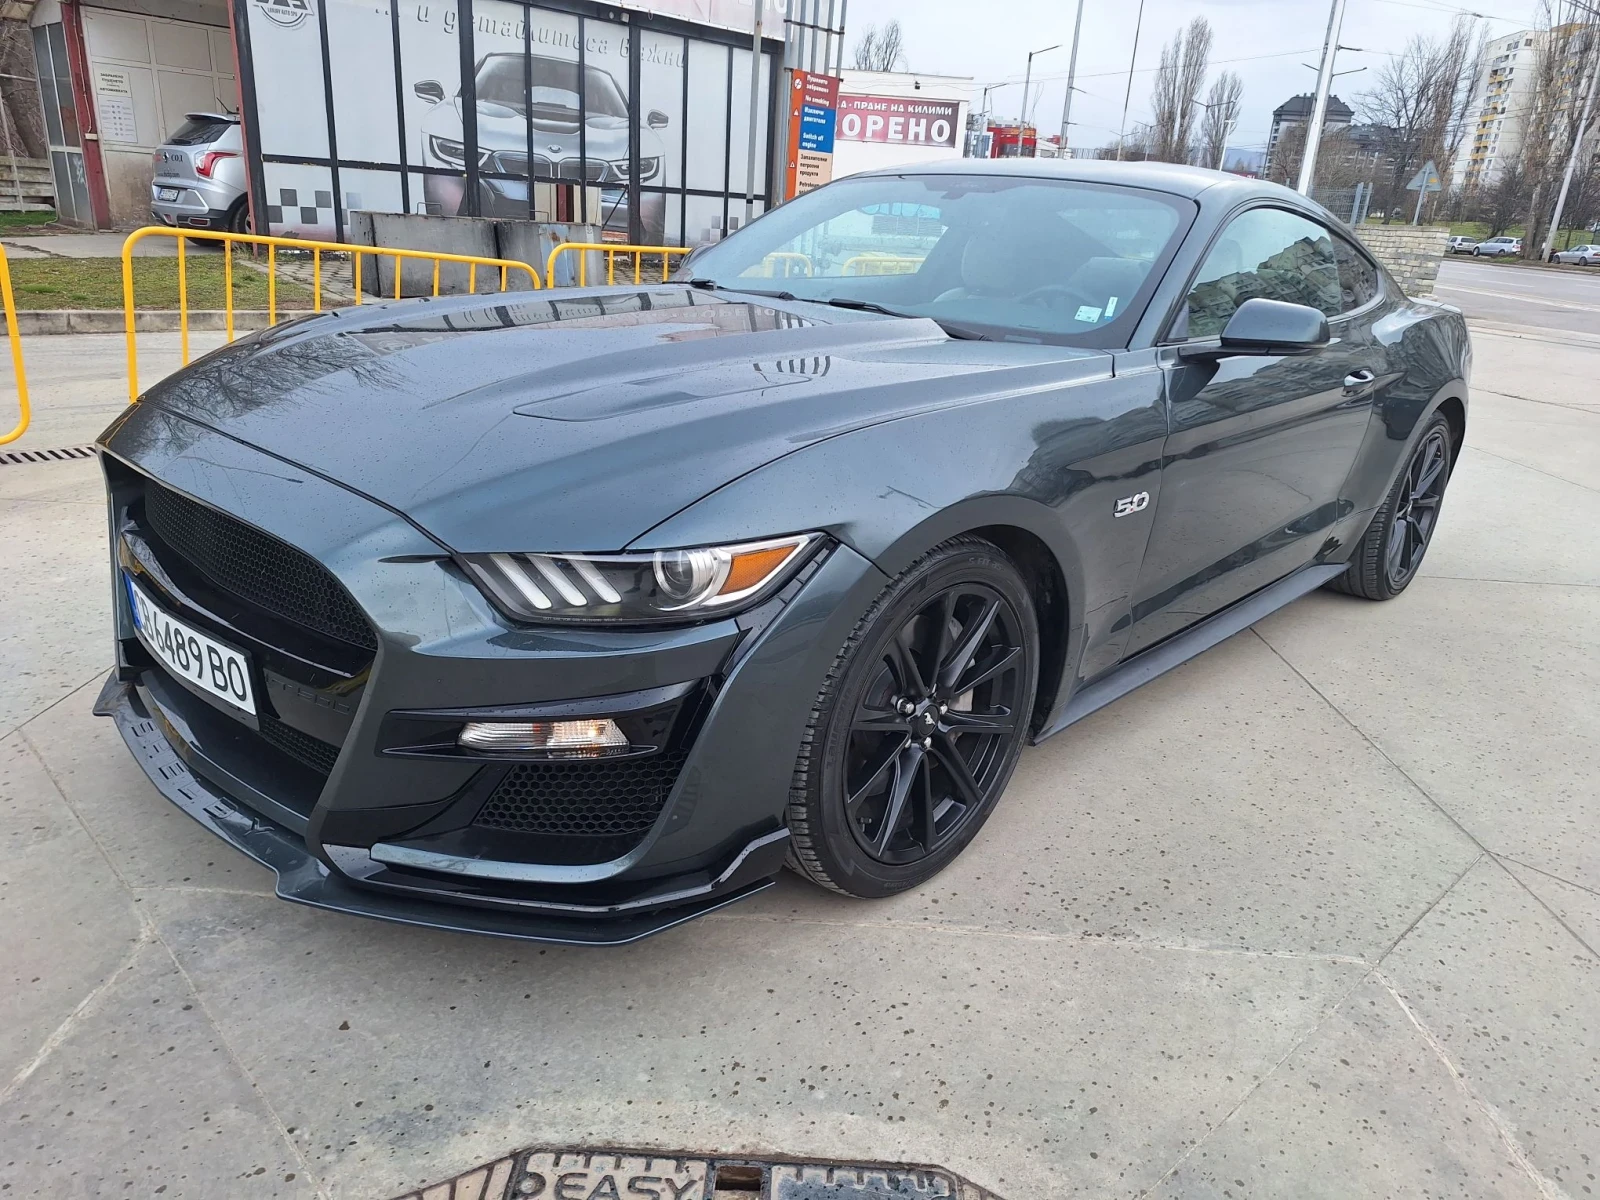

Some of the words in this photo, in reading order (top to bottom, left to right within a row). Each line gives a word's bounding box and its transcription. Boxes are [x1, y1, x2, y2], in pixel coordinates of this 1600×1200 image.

[804, 94, 812, 102] No
[811, 97, 830, 107] smoking
[853, 101, 888, 112] ПРАНЕ
[890, 103, 905, 112] НА
[907, 105, 952, 116] КИЛИМИ
[836, 113, 951, 142] ОРЕНО
[802, 132, 817, 141] Switch
[1113, 491, 1150, 518] 5.0
